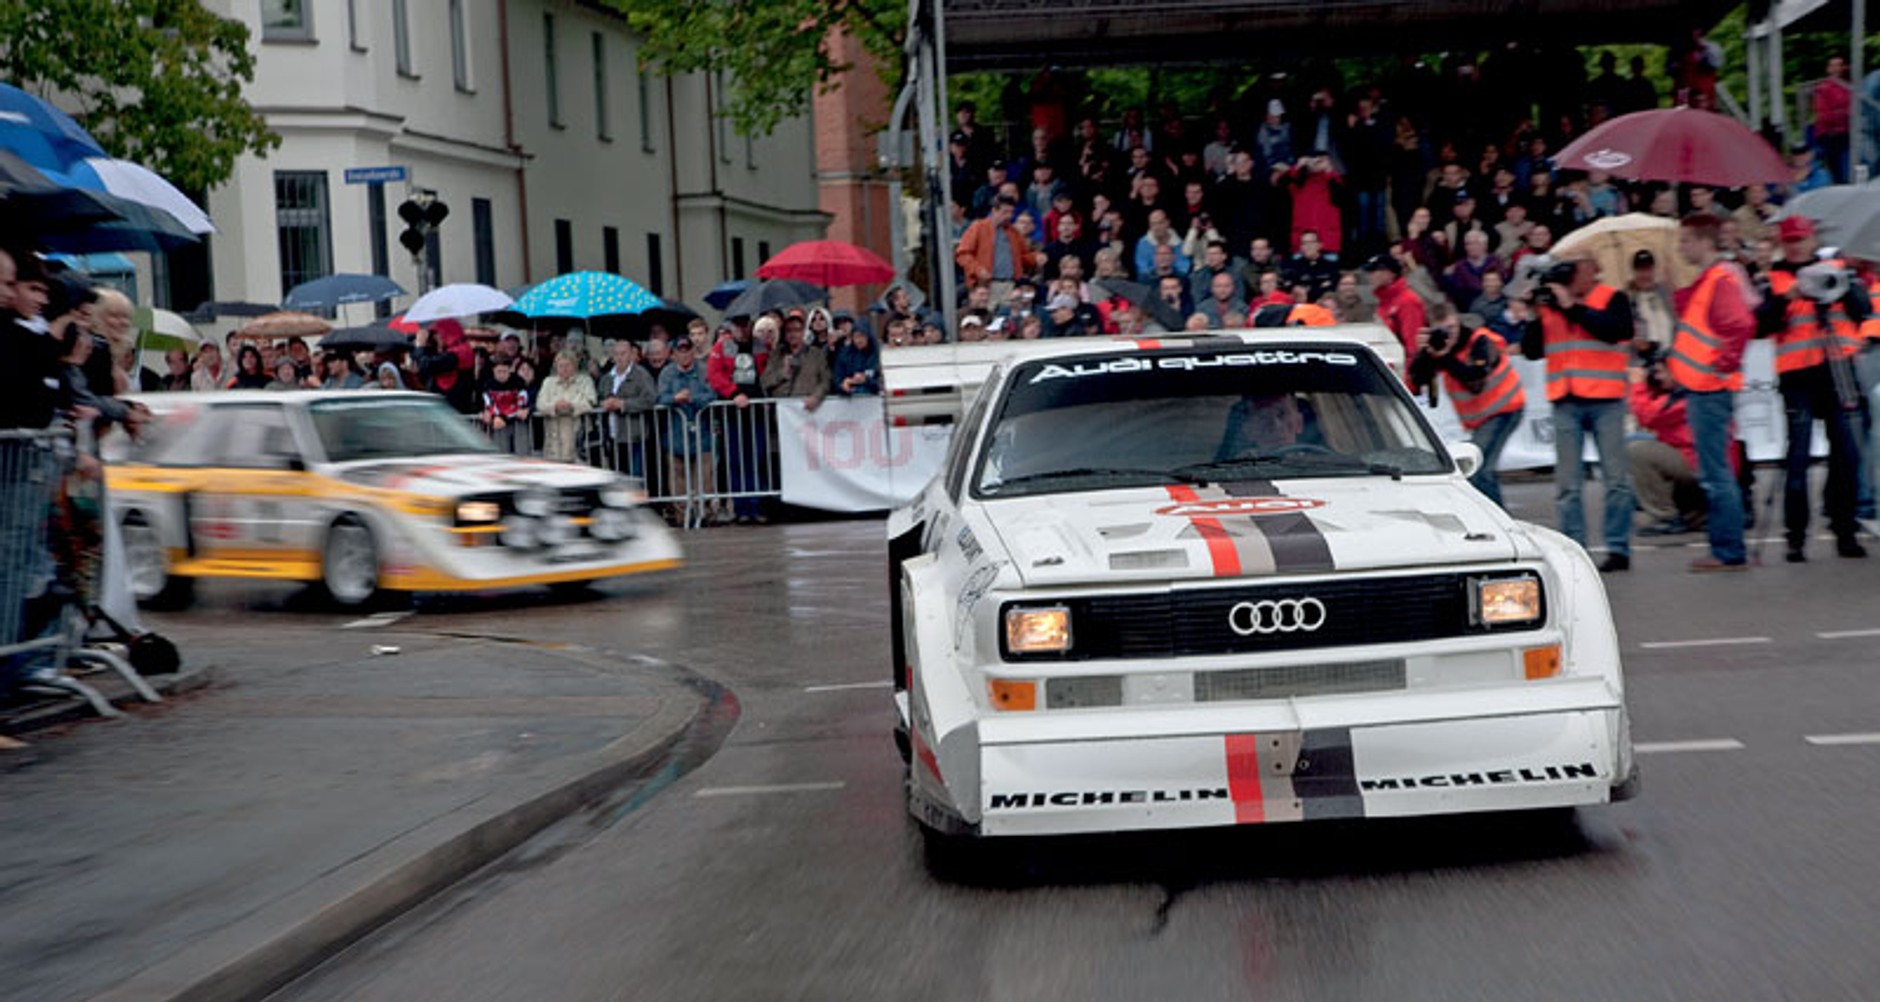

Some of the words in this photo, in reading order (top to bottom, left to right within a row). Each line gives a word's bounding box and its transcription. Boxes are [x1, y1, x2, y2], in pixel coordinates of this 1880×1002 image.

[1029, 359, 1153, 384] Audi
[1158, 350, 1357, 371] quattro
[796, 419, 913, 472] 100
[1361, 763, 1597, 792] MICHELIN
[989, 788, 1228, 809] MICHELIN
